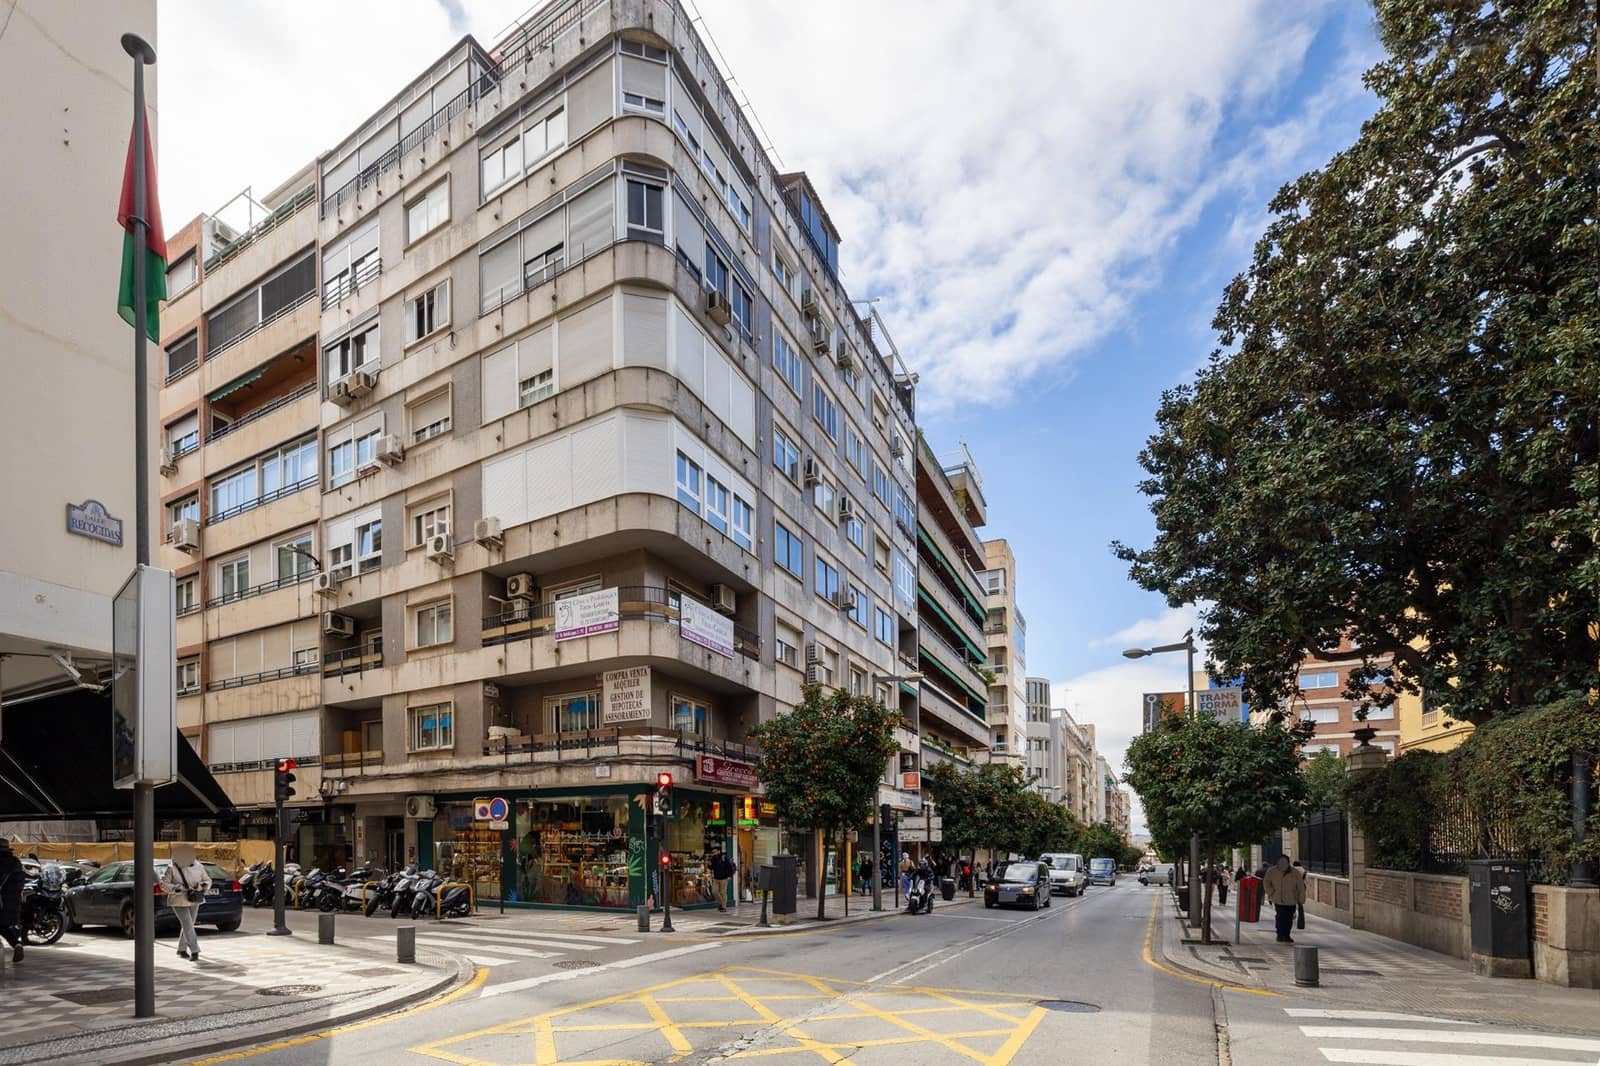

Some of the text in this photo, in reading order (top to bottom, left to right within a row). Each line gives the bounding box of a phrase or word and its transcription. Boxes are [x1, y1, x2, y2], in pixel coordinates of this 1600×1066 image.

[71, 518, 120, 540] RECOGIDAS
[605, 668, 648, 682] COMPRA VENTA
[613, 679, 641, 690] ALQUILER
[610, 690, 644, 702] GESTION DE
[1200, 692, 1237, 701] TRANS
[611, 700, 643, 711] HIPOTECAS
[1200, 700, 1238, 709] FORMA
[605, 708, 650, 721] ASESORAMIENTO
